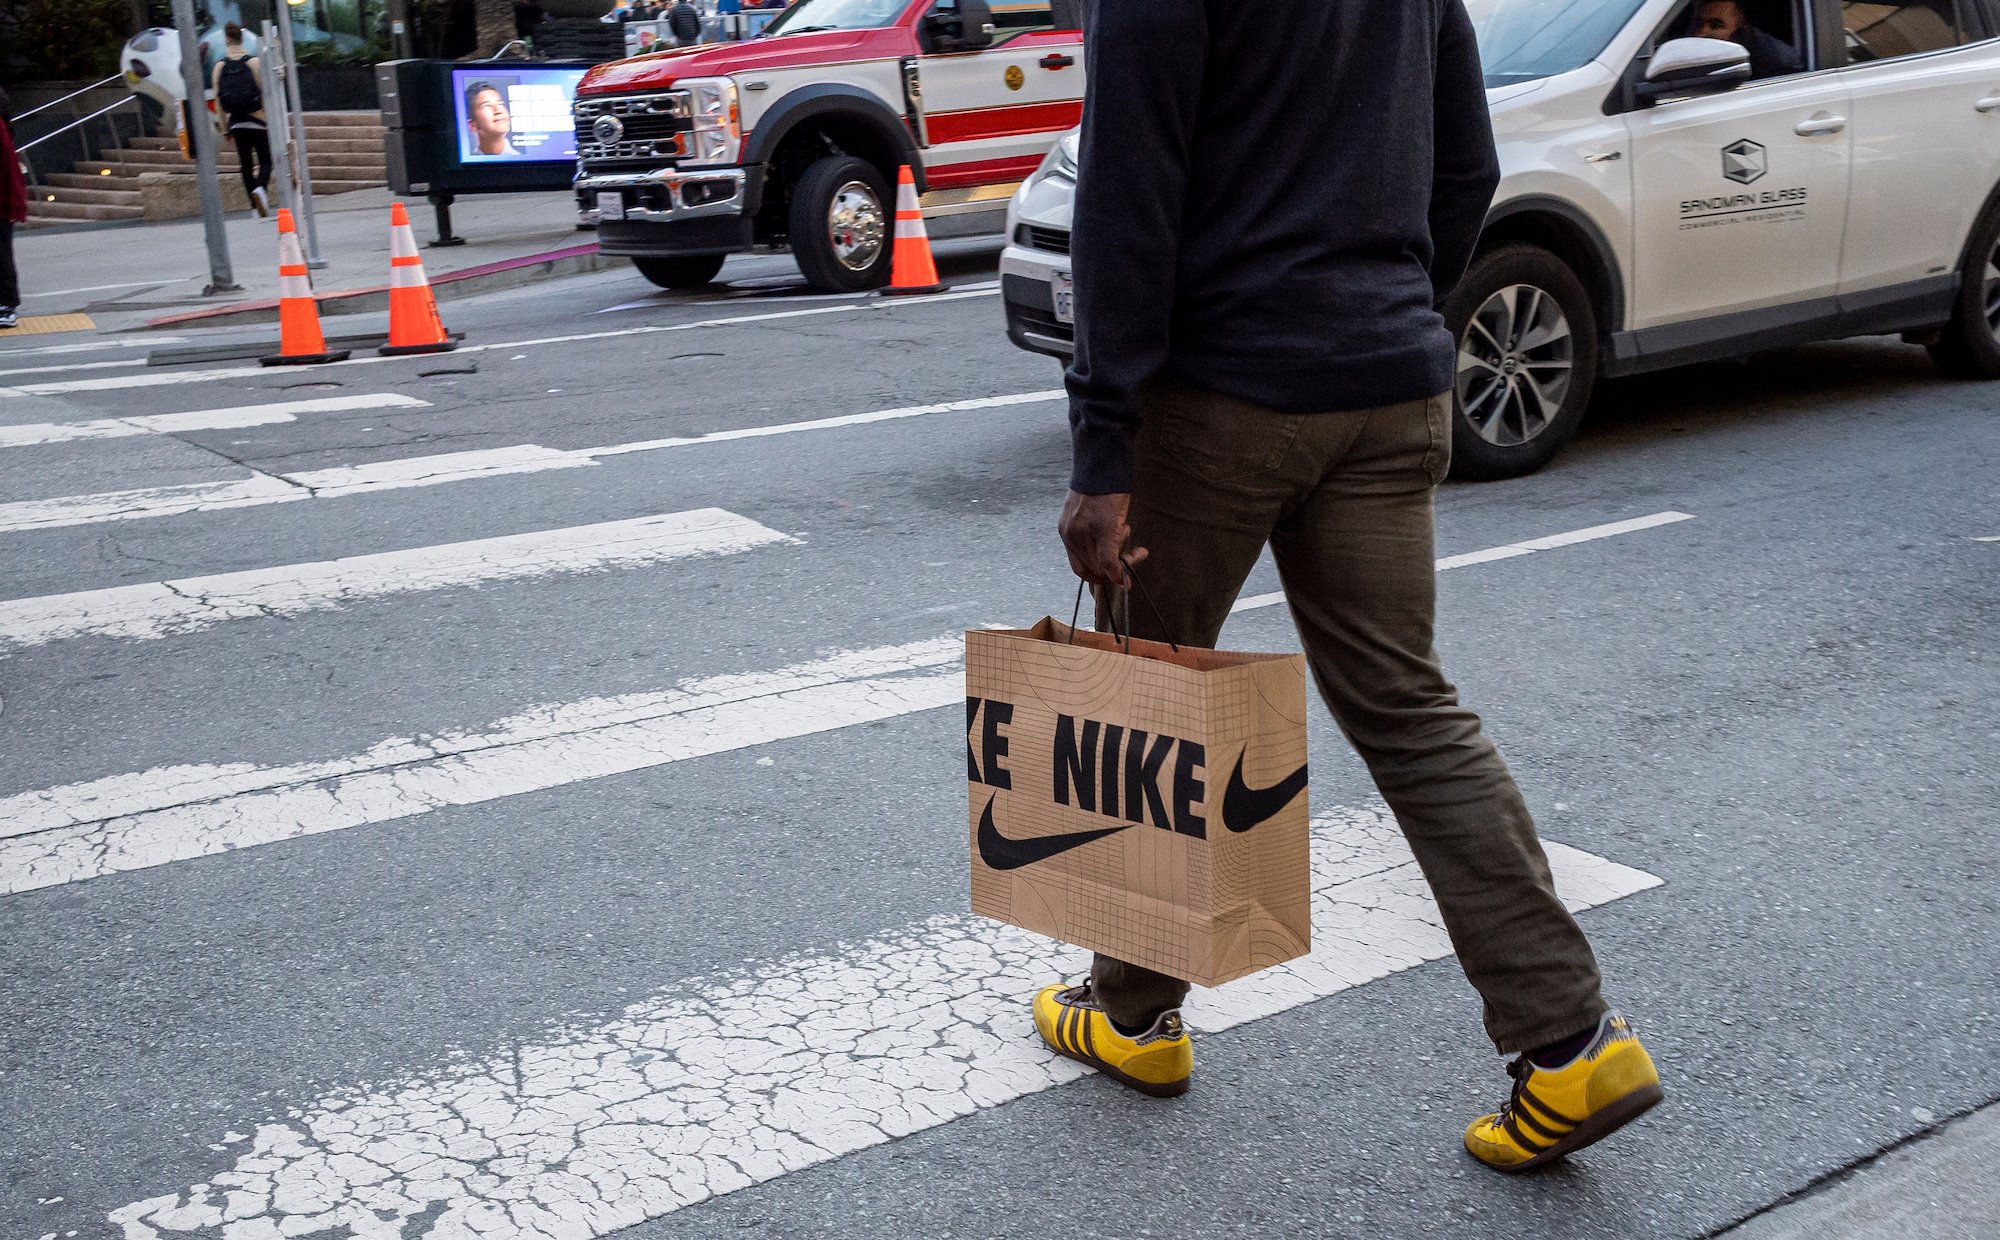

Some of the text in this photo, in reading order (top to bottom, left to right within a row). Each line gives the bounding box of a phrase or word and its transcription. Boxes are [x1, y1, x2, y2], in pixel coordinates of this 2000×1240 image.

[1679, 187, 1808, 213] SANDMAN GLASS
[1053, 713, 1206, 840] NIKE
